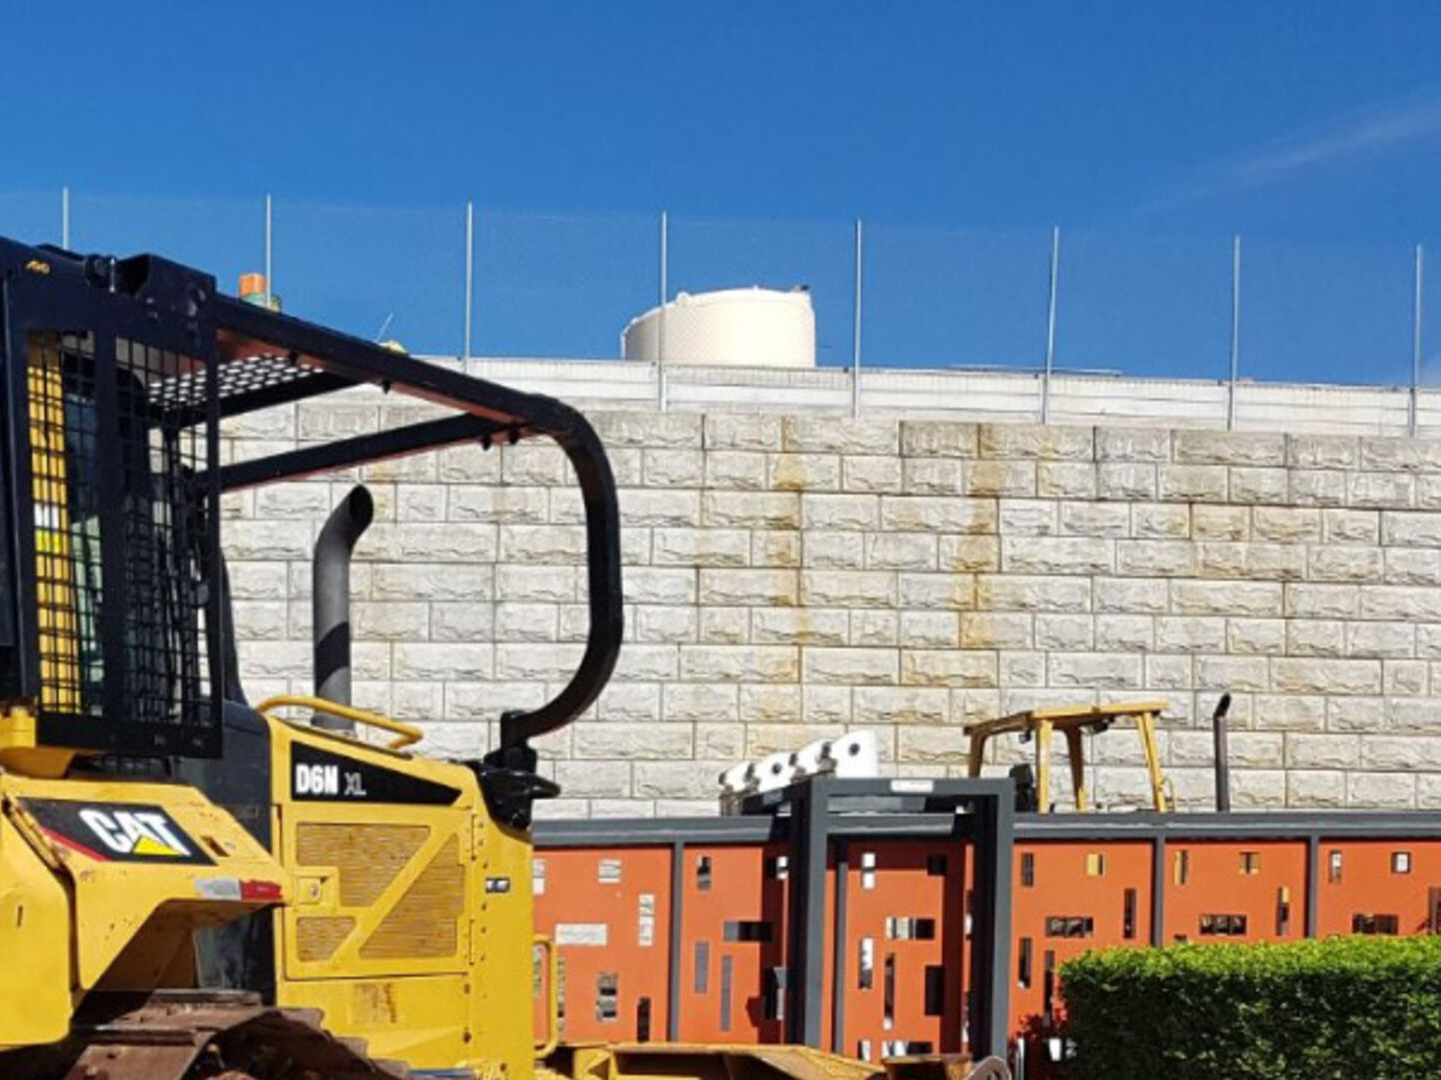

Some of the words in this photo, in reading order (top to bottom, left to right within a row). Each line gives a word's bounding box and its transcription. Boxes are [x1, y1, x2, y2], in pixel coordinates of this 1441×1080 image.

[295, 763, 338, 794] D6N
[344, 772, 367, 796] XL
[78, 808, 192, 857] CAT
